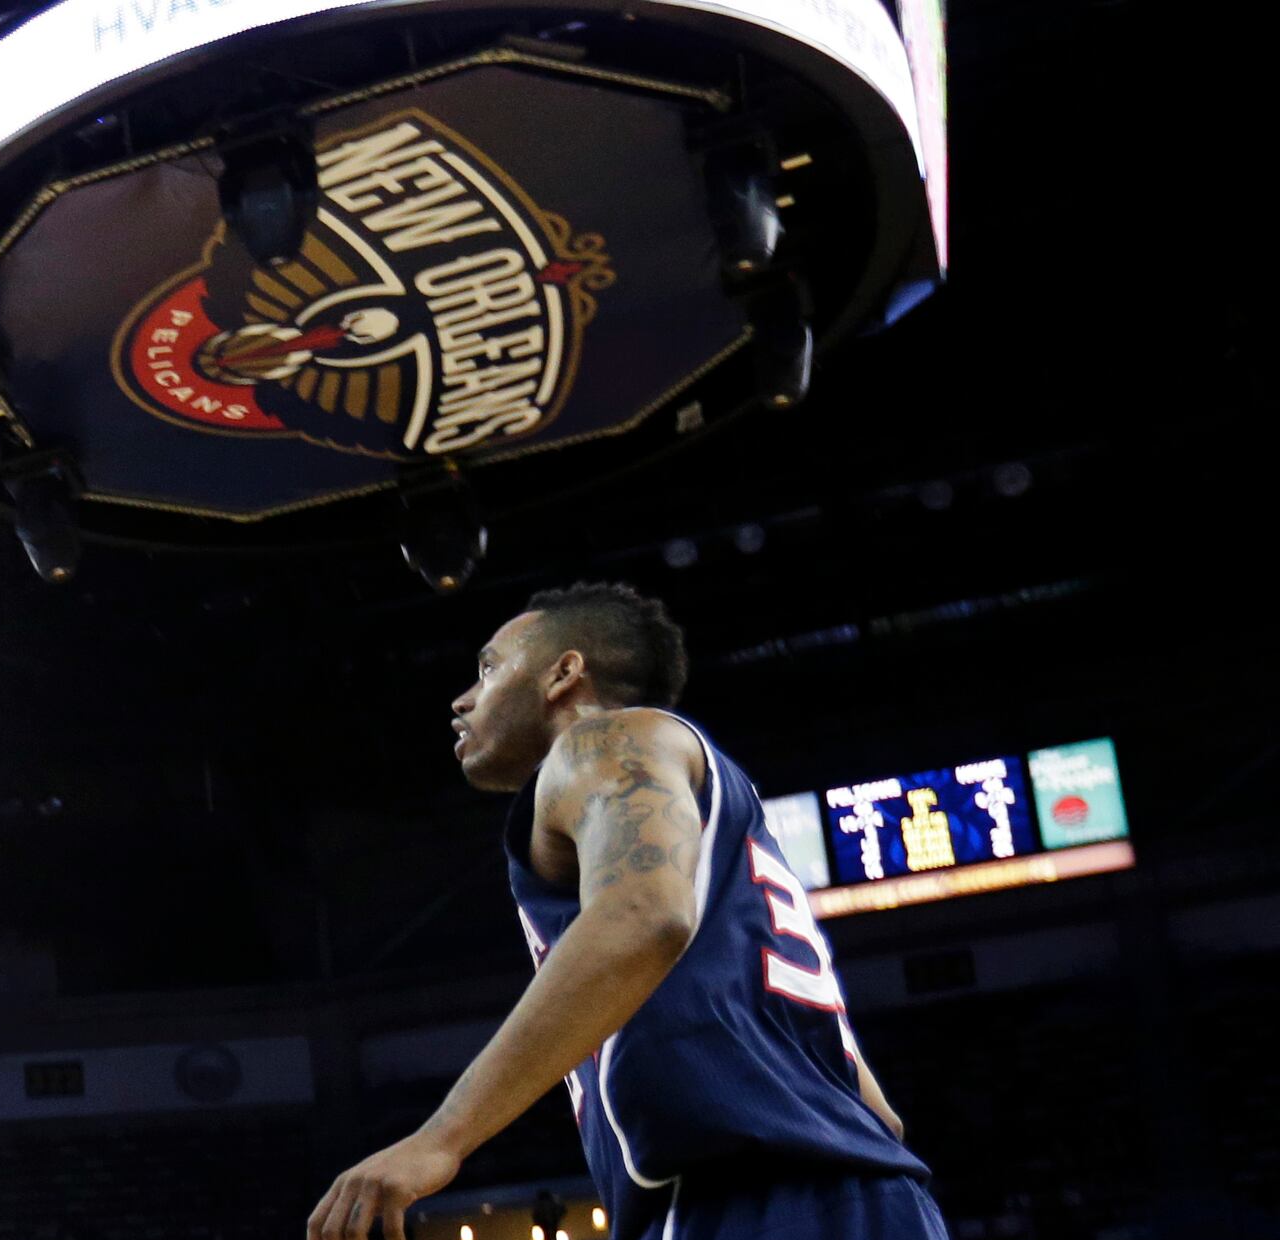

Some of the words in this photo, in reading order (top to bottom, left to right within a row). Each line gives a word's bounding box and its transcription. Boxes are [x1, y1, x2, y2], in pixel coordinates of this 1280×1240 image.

[146, 308, 250, 421] PELICANS
[317, 122, 502, 252] NEW
[413, 246, 543, 455] ORLEANS
